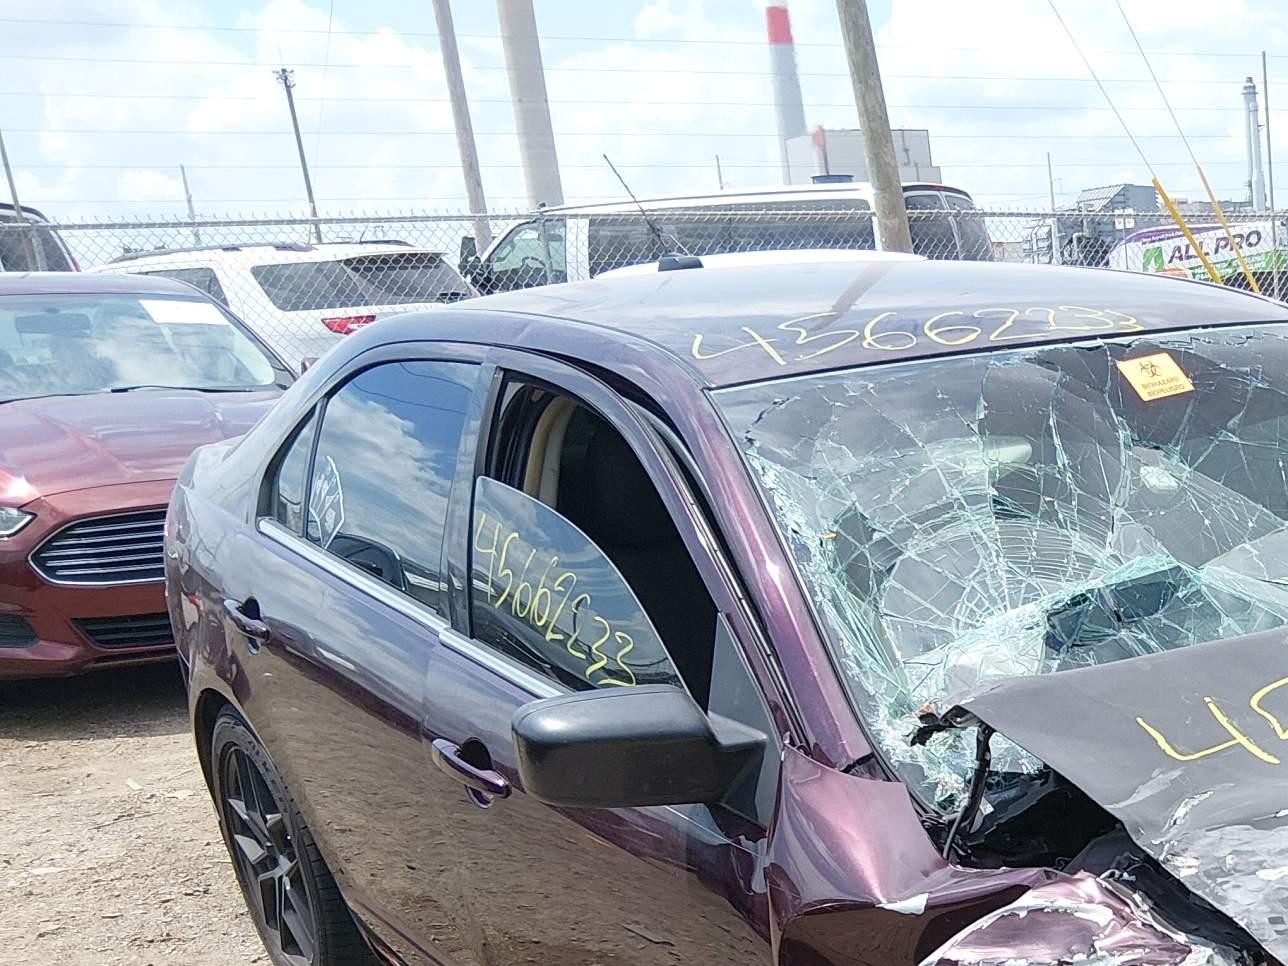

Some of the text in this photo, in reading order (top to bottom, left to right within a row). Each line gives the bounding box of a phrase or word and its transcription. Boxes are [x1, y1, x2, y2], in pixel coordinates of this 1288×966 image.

[1168, 229, 1262, 264] ALL PRO
[1141, 376, 1180, 390] BIOHAZARD
